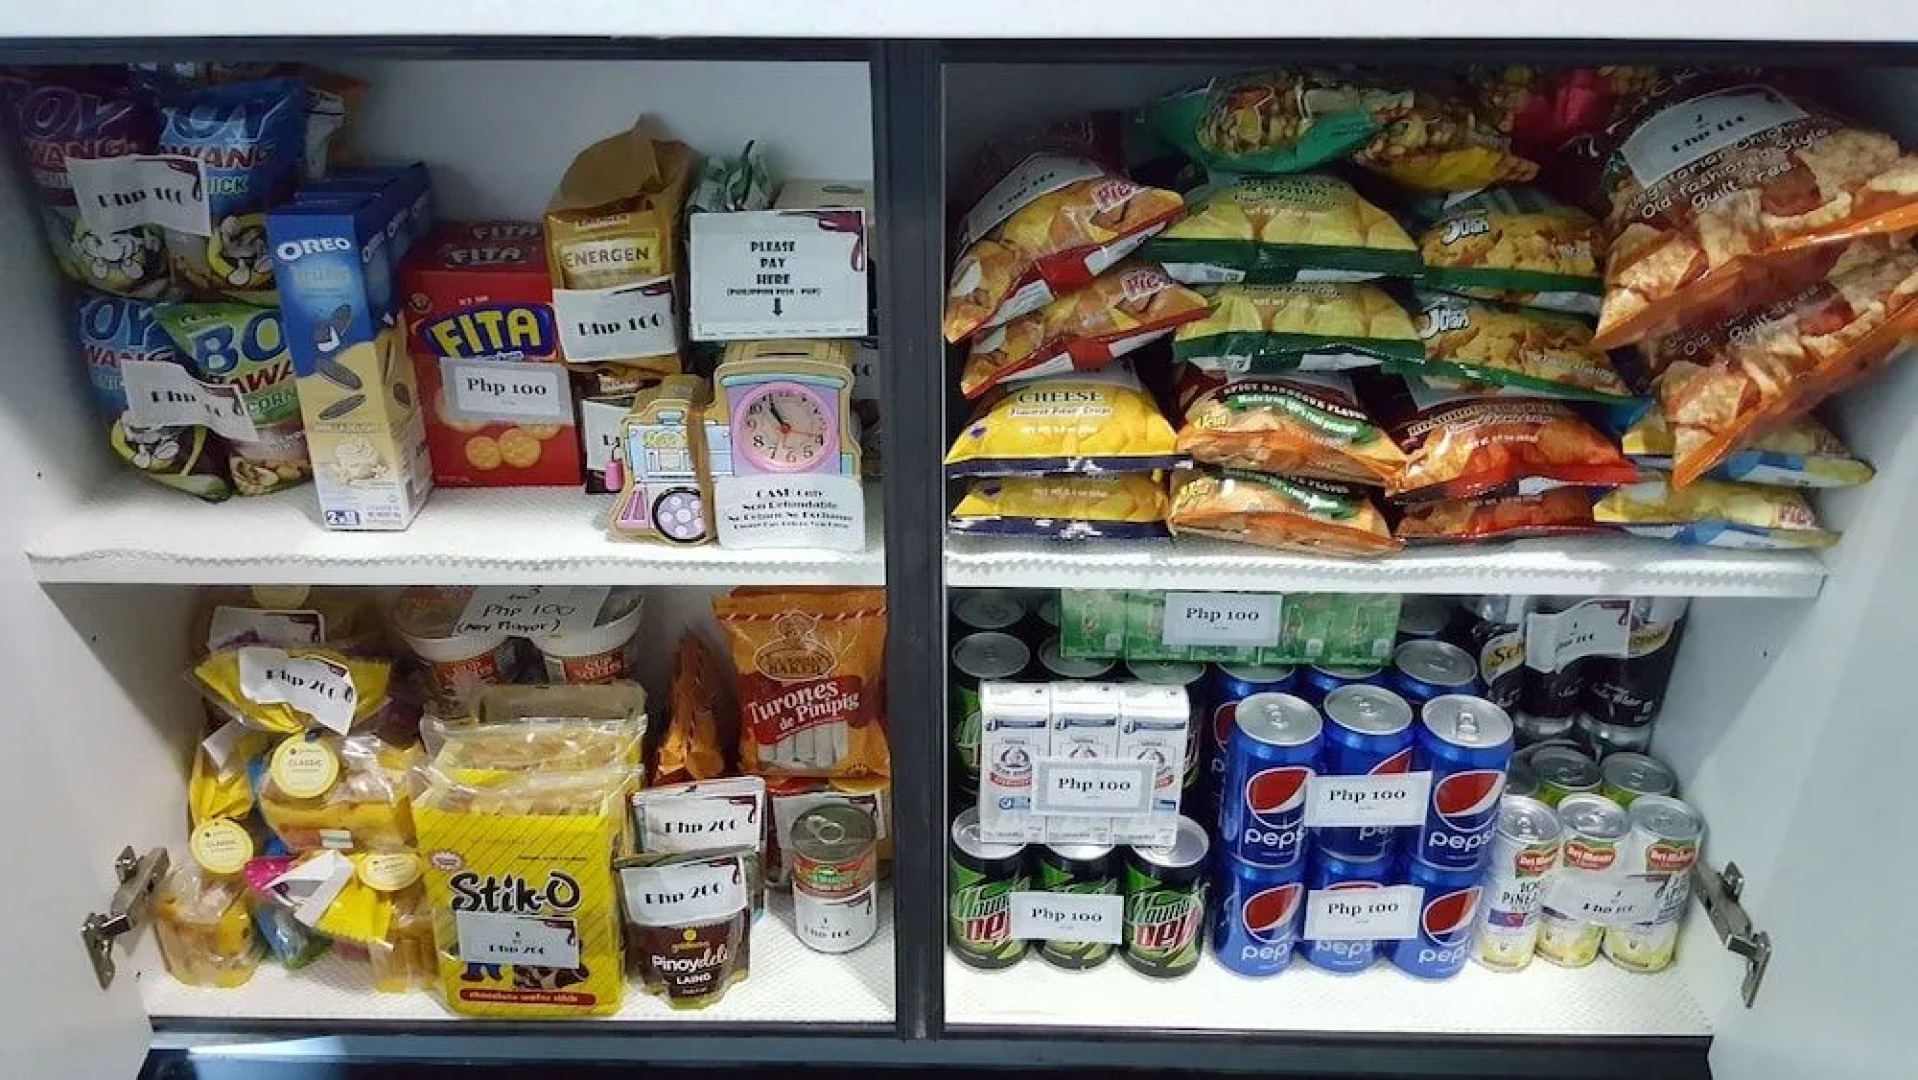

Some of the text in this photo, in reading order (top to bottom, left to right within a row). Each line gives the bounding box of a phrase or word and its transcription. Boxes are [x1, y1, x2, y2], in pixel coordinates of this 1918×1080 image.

[277, 237, 352, 262] OREO
[750, 241, 796, 253] PLEASE
[563, 246, 650, 267] ENERGEN
[760, 257, 786, 269] PAY
[757, 273, 791, 285] HERE
[430, 308, 542, 359] FITA
[189, 312, 291, 374] BO
[466, 378, 548, 396] Php 100
[1018, 391, 1104, 403] CHEESE
[1186, 607, 1259, 622] Php 100
[748, 681, 839, 724] Turones
[795, 692, 860, 724] Pinipig
[1058, 778, 1132, 792] Php 100
[1329, 789, 1407, 804] Php 100
[450, 872, 580, 912] Stik-O
[1031, 906, 1103, 922] Php 100
[1327, 902, 1400, 917] Php 100
[677, 973, 713, 986] LAING
